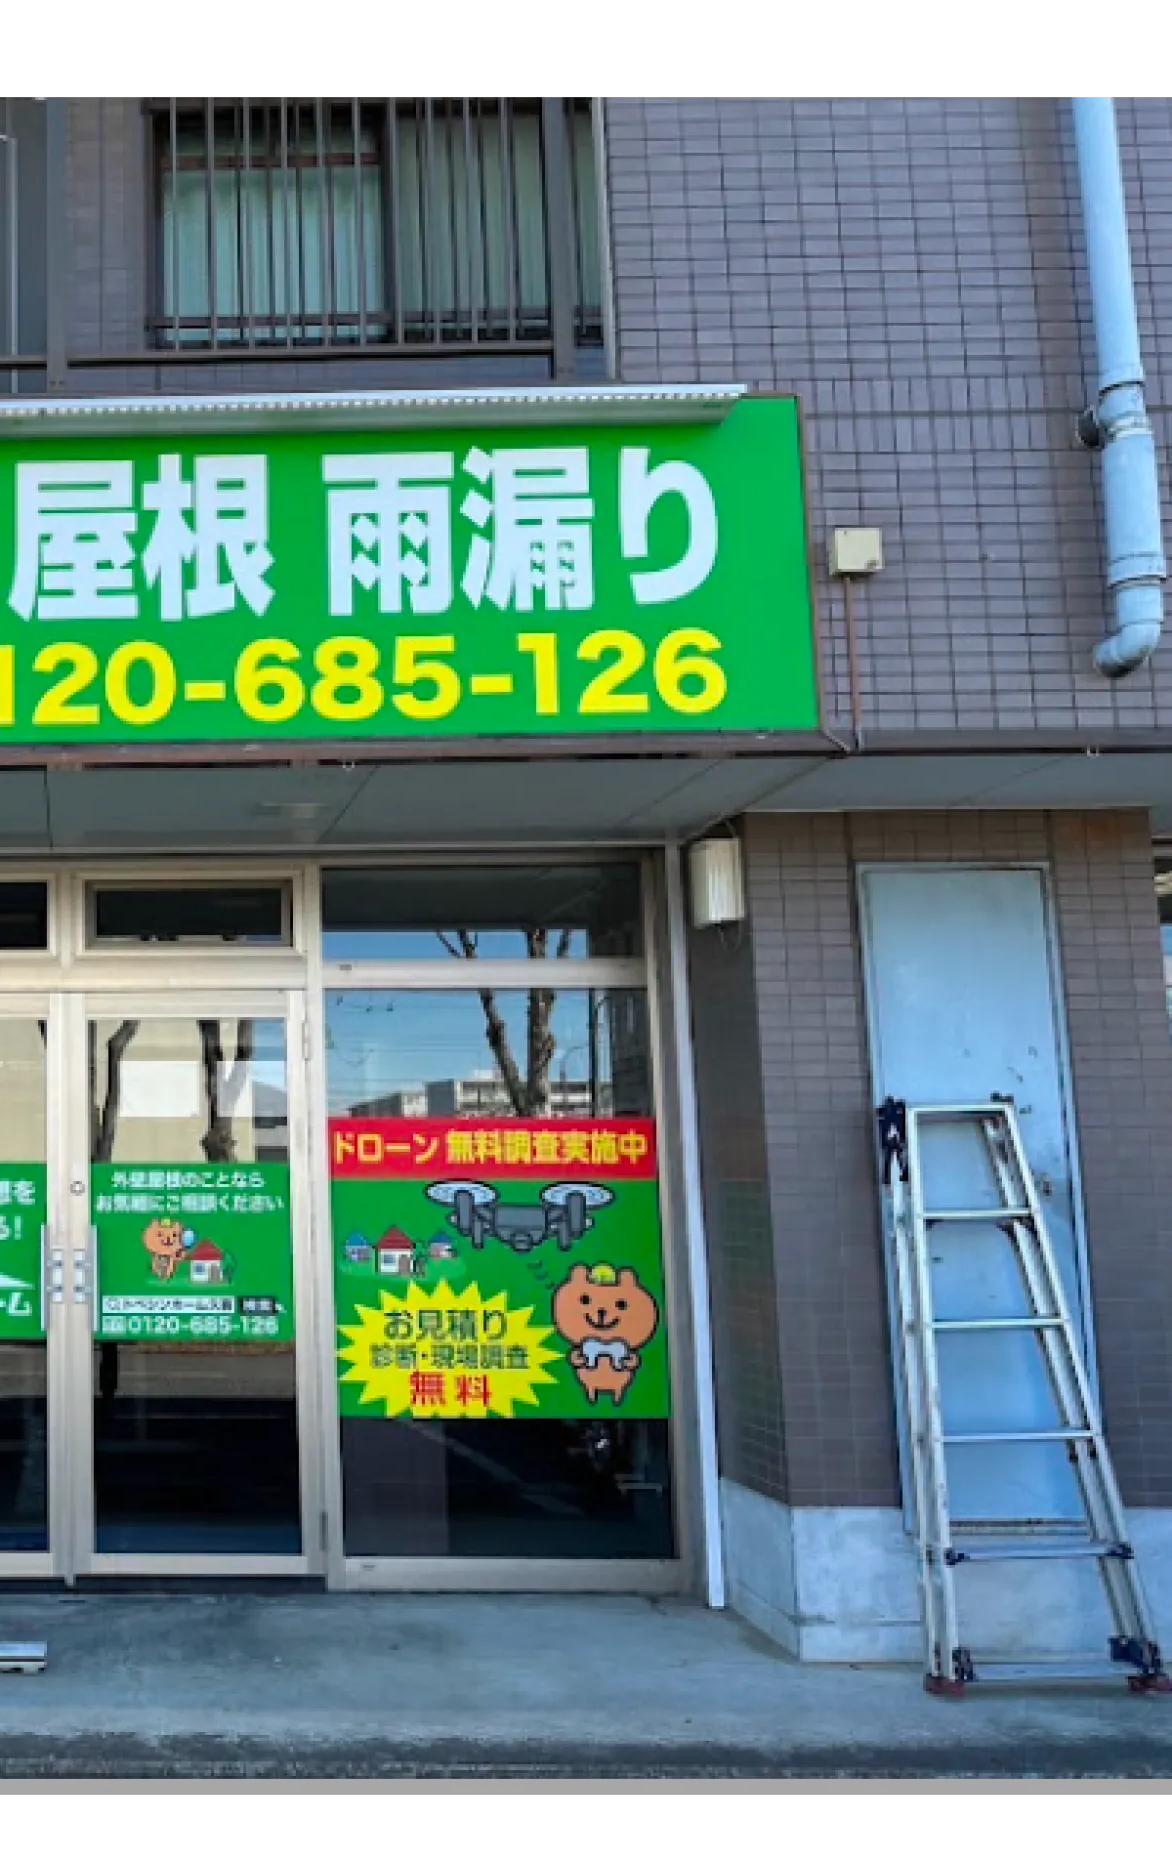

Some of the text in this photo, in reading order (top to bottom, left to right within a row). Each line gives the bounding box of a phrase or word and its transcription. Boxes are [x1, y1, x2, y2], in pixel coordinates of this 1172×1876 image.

[8, 453, 274, 621] 屋根
[322, 446, 719, 616] 雨漏り
[335, 1130, 646, 1164] ドローン 無料調査実施中
[128, 1315, 279, 1335] 0120-685-126
[383, 1308, 508, 1341] お見積り
[409, 1370, 492, 1406] 無料
